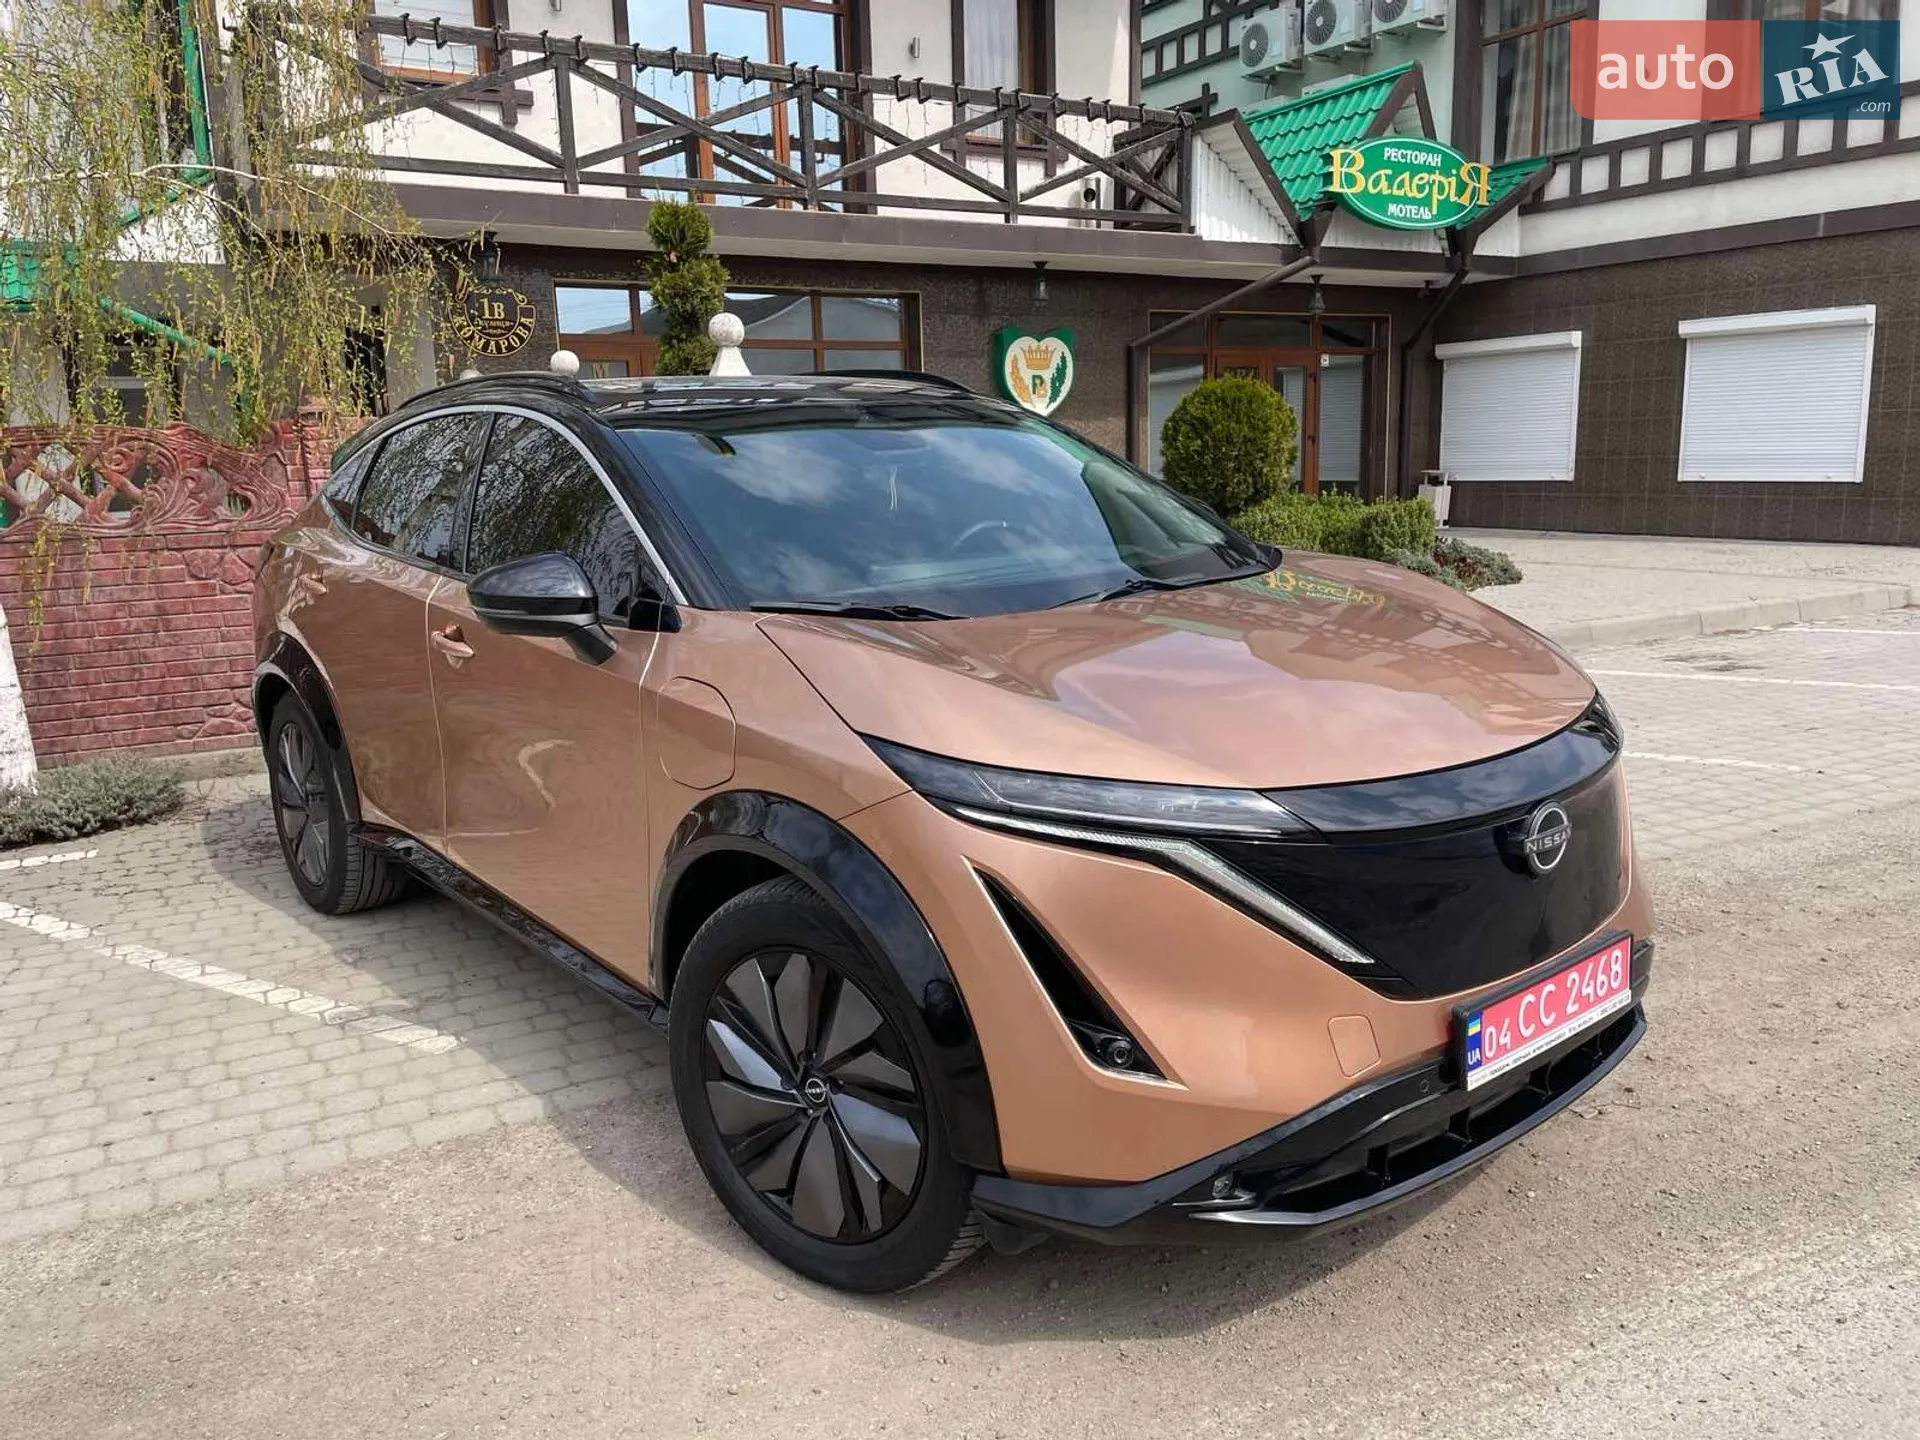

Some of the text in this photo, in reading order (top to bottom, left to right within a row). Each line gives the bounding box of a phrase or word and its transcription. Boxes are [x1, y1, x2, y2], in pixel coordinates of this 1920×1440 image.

[1383, 147, 1442, 167] РЕСТОРАН
[1388, 203, 1432, 220] МОТЕЛЬ
[1484, 1017, 1512, 1059] 04
[1518, 983, 1557, 1038] CC
[1565, 949, 1623, 1017] 2468
[1467, 1047, 1481, 1065] UA
